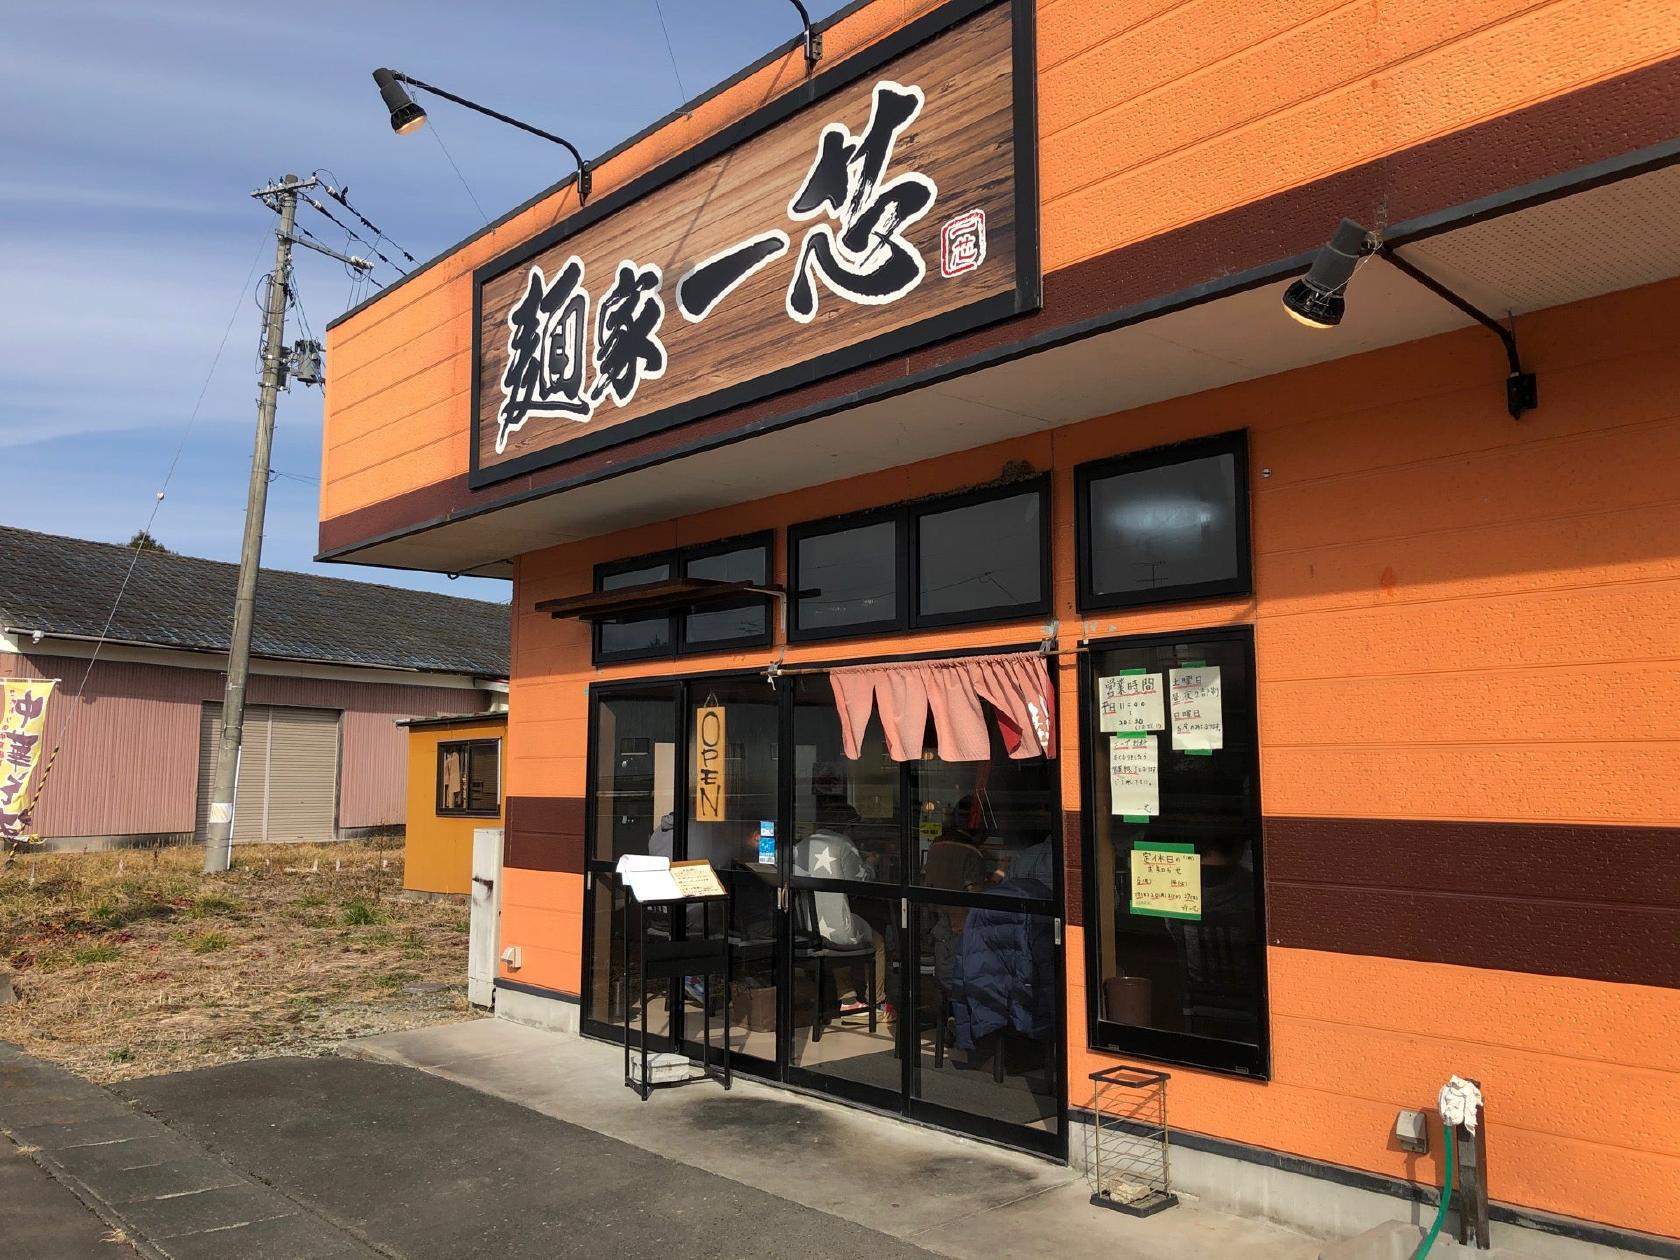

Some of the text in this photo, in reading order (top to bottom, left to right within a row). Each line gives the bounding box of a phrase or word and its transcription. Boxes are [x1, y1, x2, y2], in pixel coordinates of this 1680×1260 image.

[1105, 678, 1155, 698] 営業時間
[700, 711, 720, 816] OPEN
